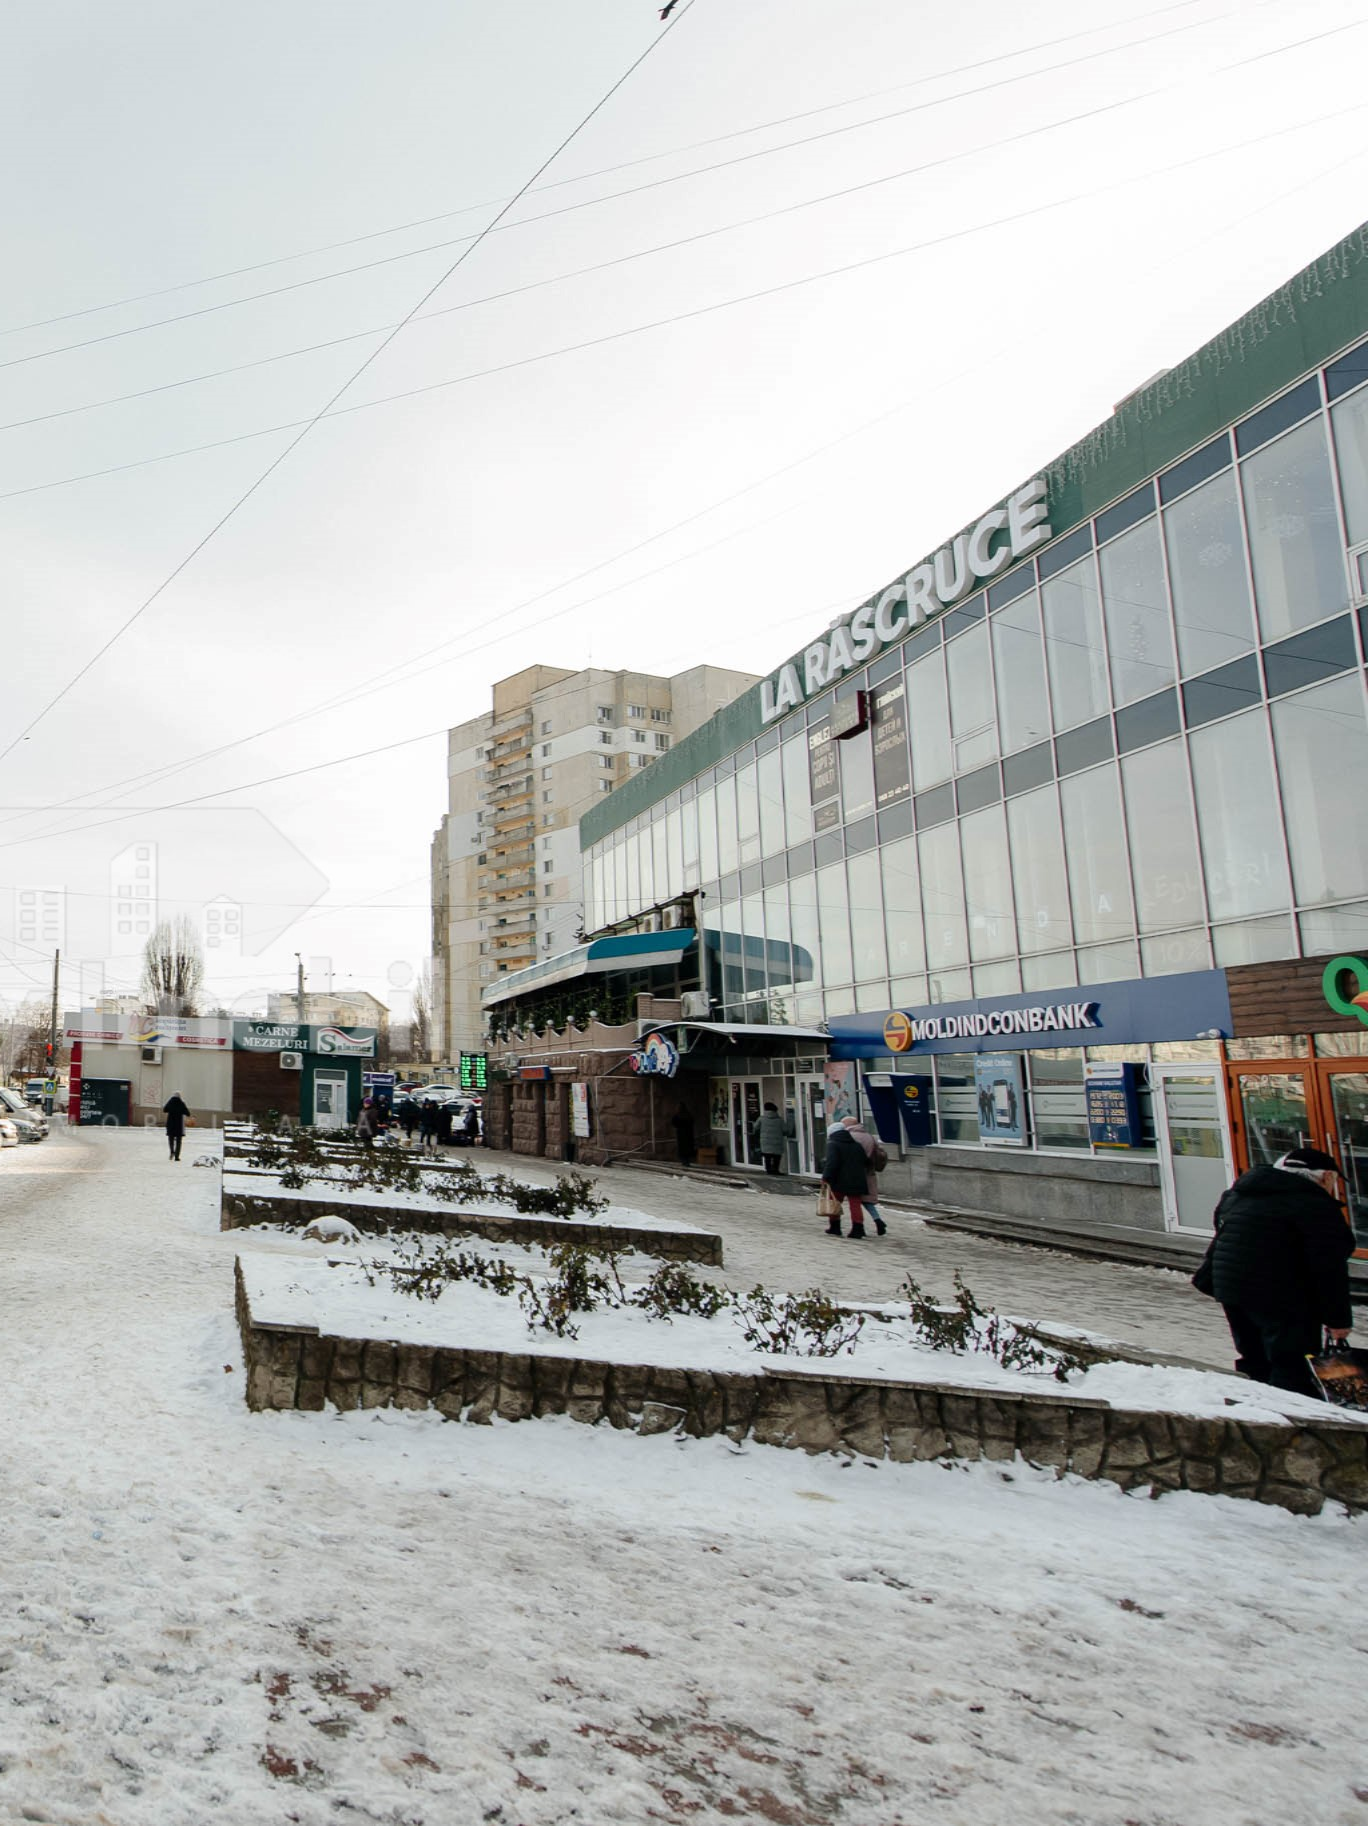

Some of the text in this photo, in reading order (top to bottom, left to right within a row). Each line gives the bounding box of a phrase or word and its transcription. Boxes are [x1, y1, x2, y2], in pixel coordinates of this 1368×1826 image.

[761, 479, 1052, 725] LA RĂSCRUCE
[256, 1026, 299, 1038] CARNE
[911, 1001, 1096, 1041] MOLDINDCONBANK
[243, 1036, 309, 1050] MEZELURI
